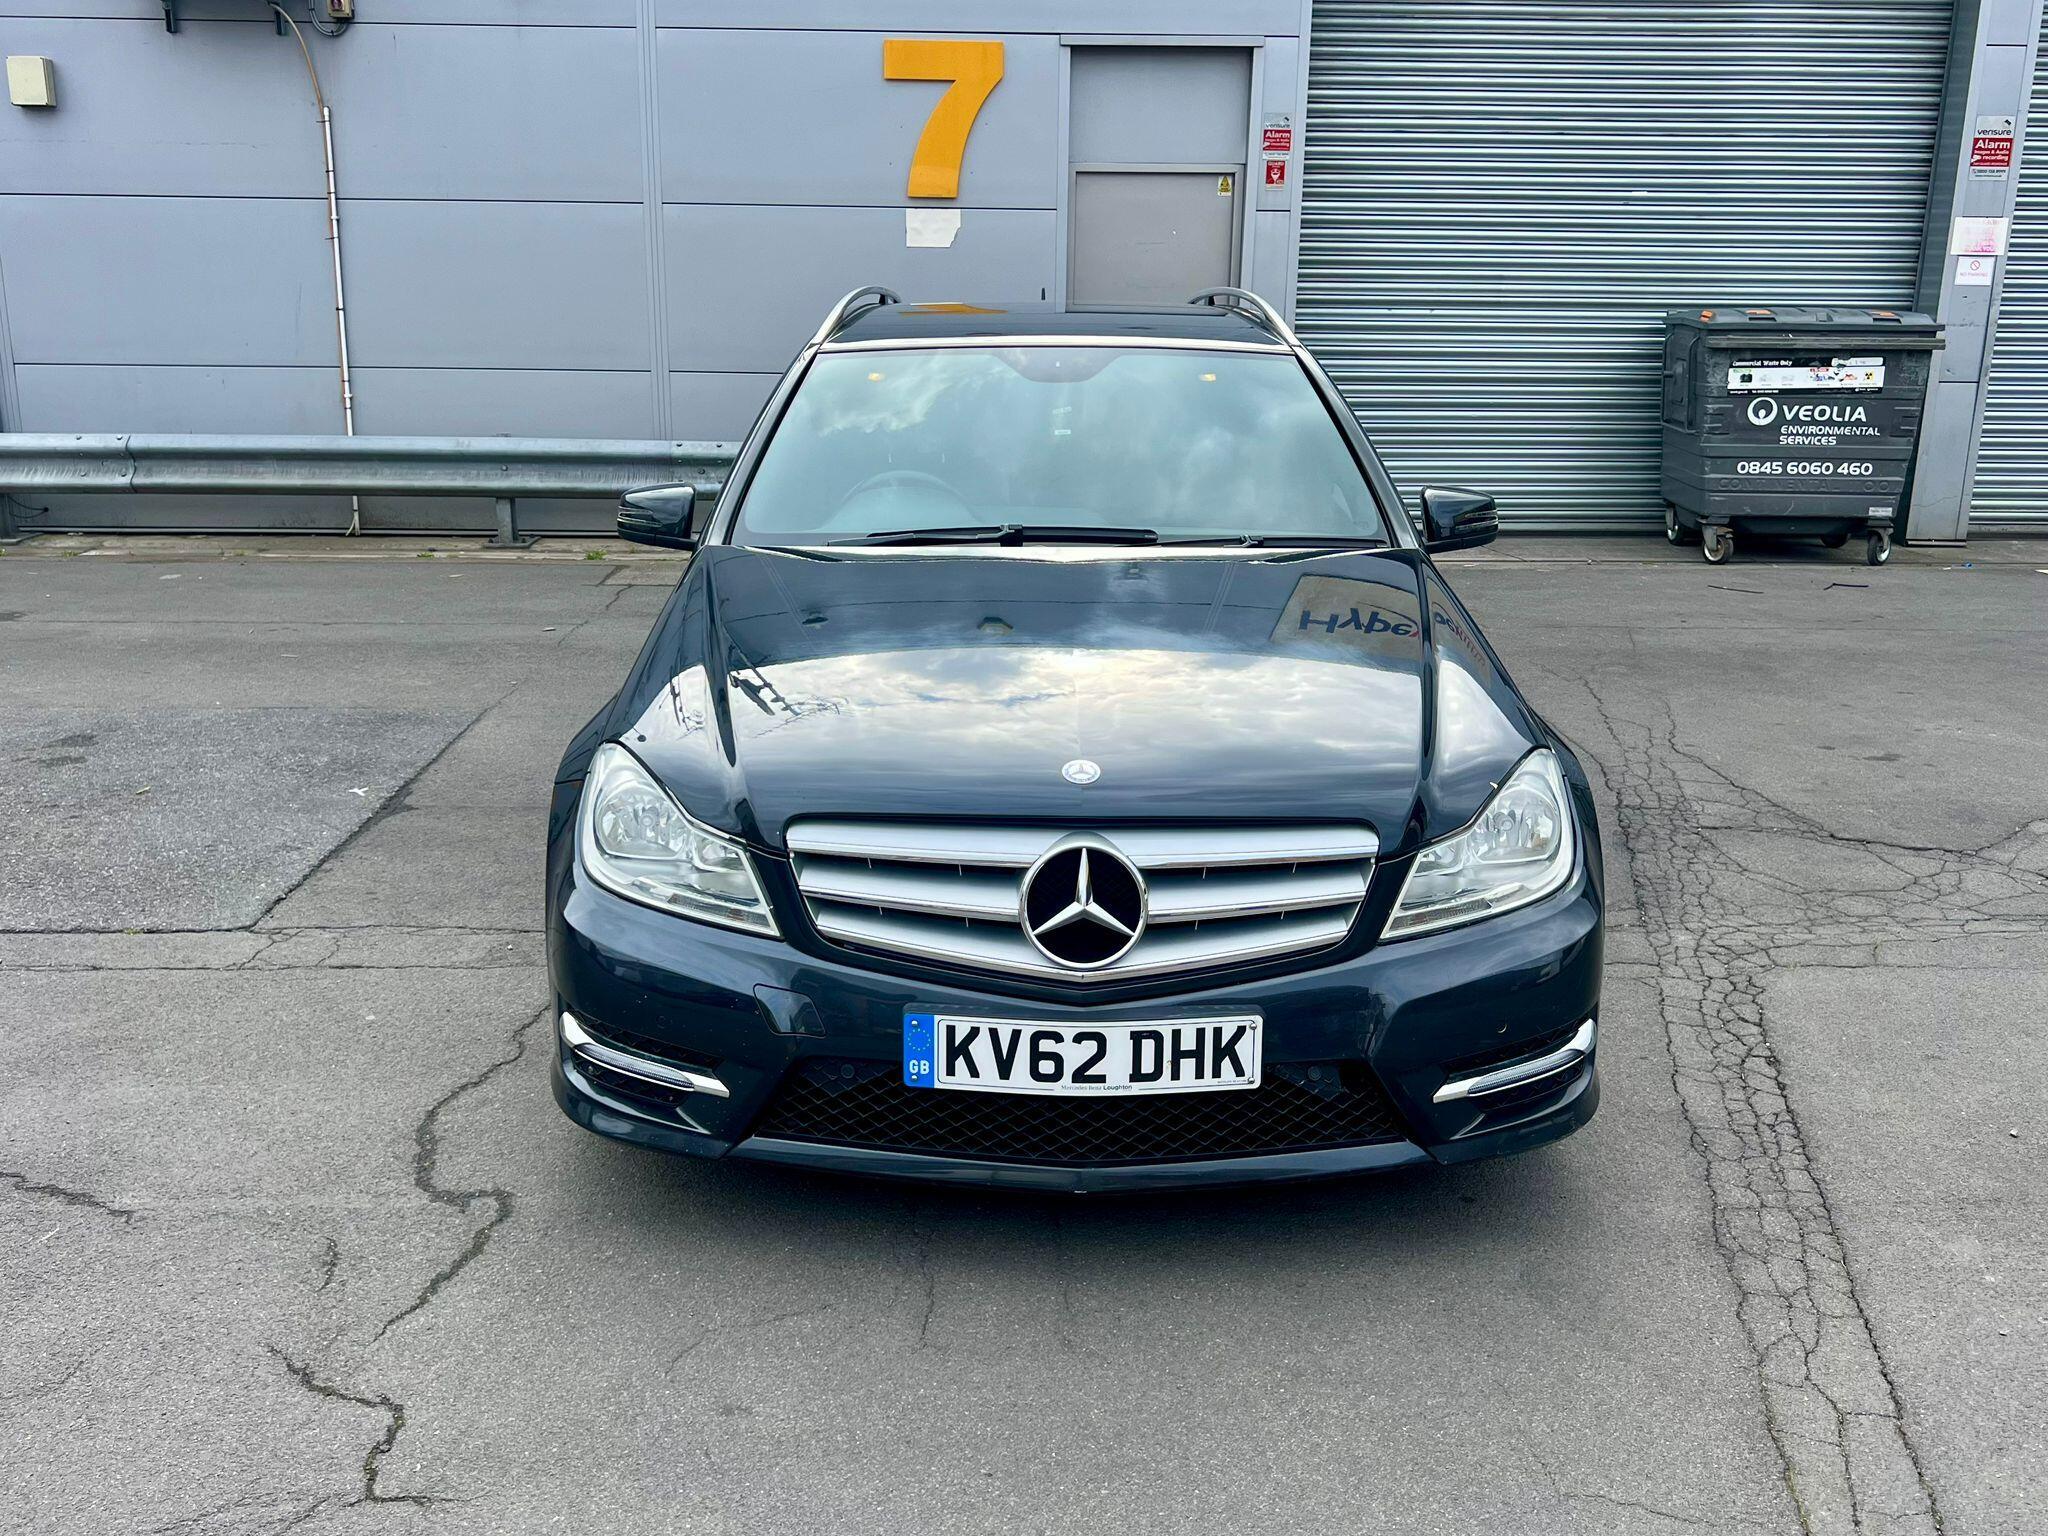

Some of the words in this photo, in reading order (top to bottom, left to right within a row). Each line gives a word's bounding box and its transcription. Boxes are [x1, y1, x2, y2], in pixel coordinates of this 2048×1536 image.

[883, 39, 1004, 199] 7
[1975, 139, 2011, 149] Alarm
[1782, 404, 1867, 422] VEOLIA
[1780, 425, 1881, 437] ENVIRONMENTAL
[1779, 435, 1837, 446] SERVICES
[1736, 461, 1783, 476] 0845
[1786, 461, 1834, 476] 6060
[1837, 461, 1874, 476] 460
[945, 1024, 1107, 1083] KV62
[1128, 1024, 1247, 1083] DHK
[908, 1059, 931, 1075] GB
